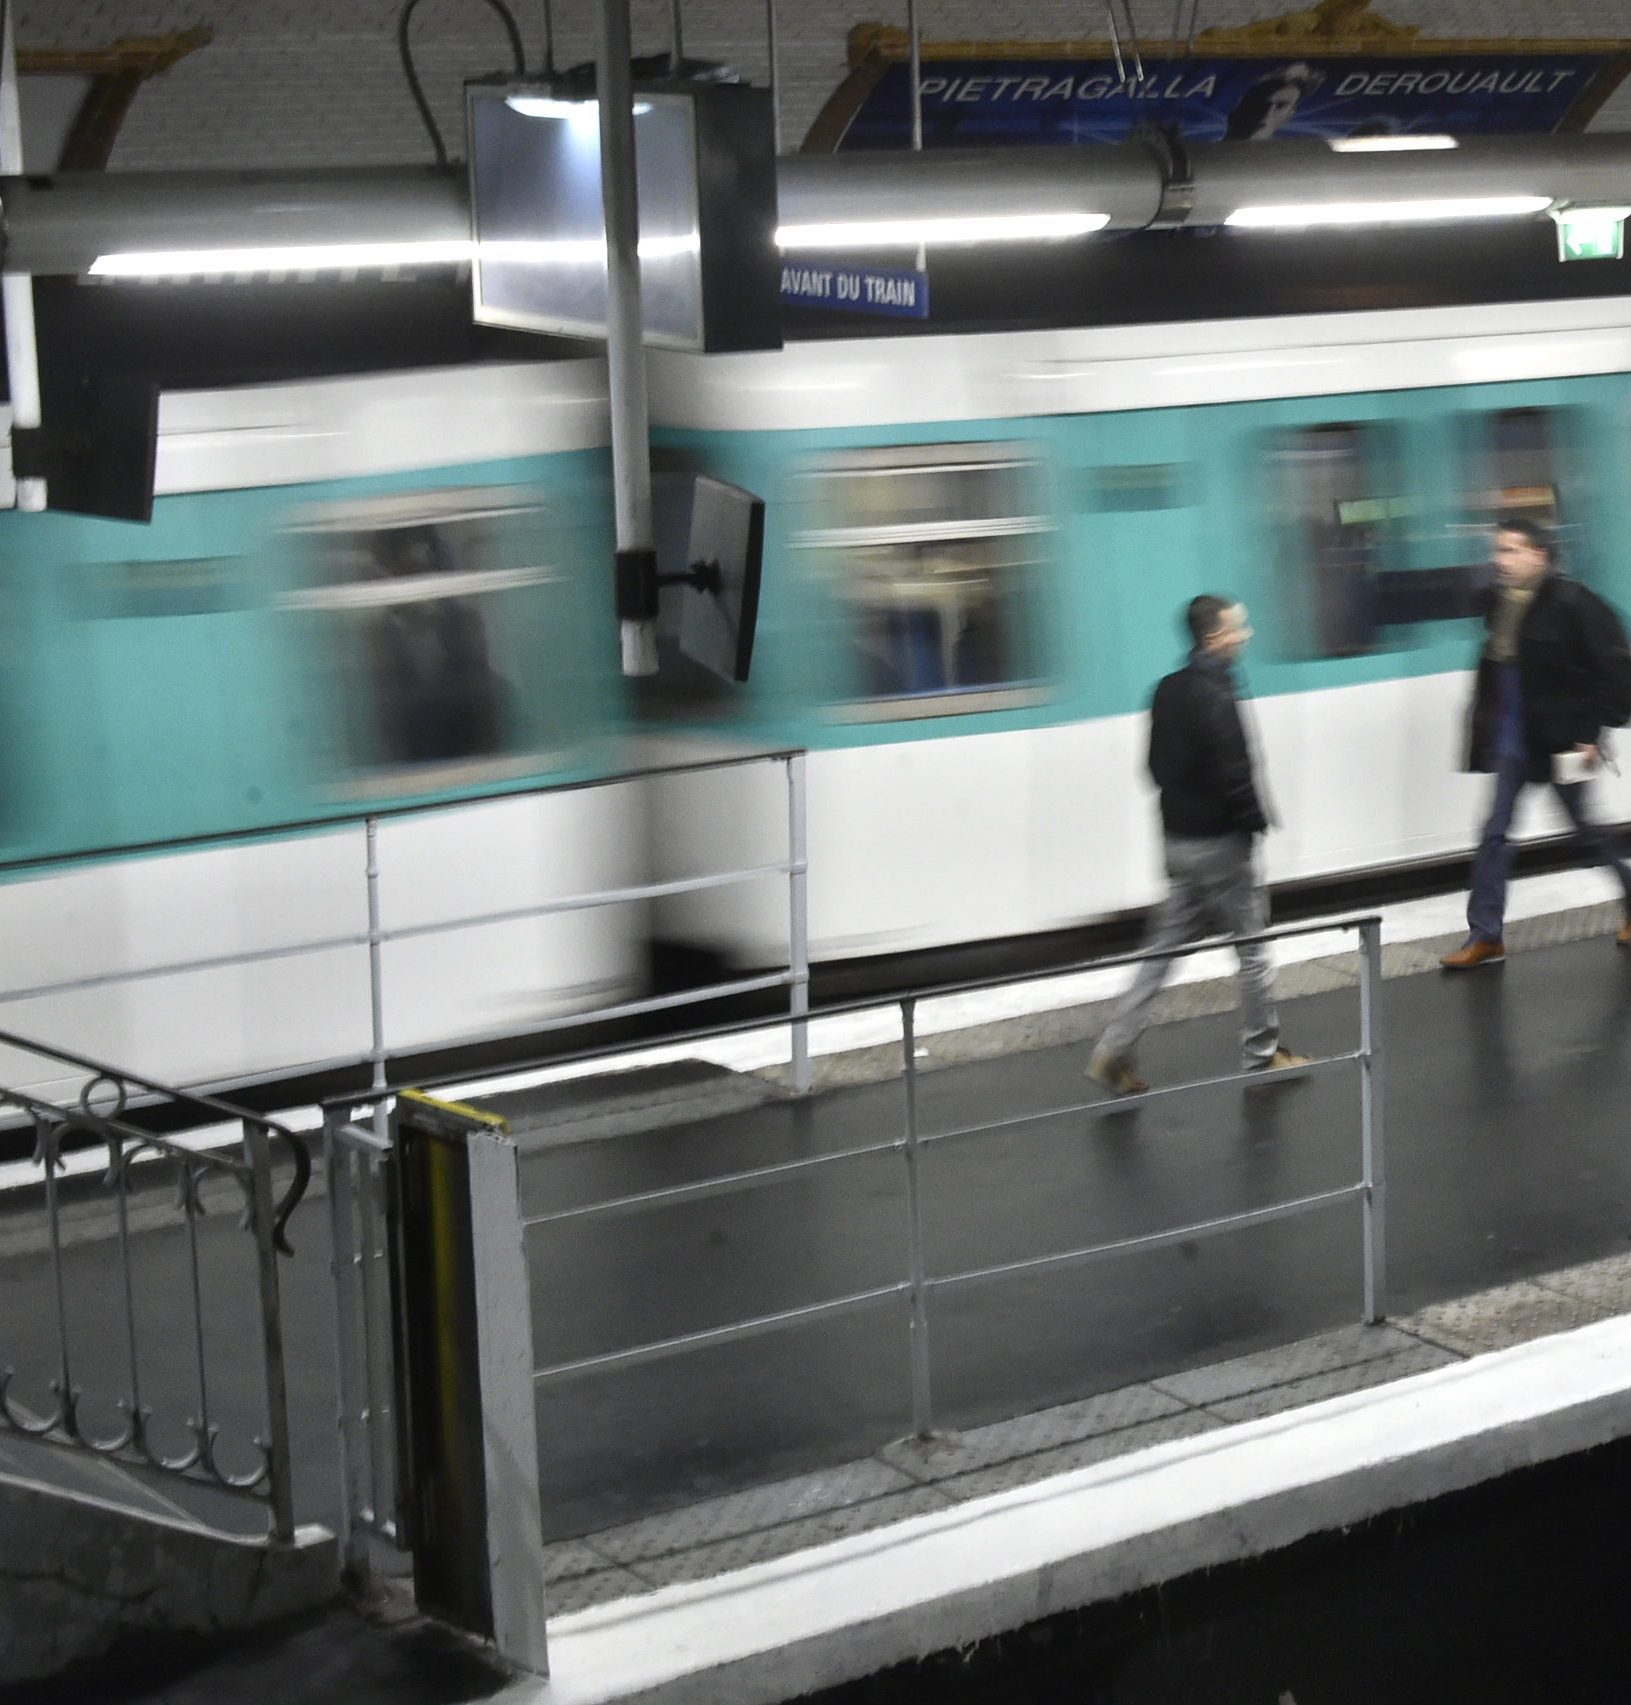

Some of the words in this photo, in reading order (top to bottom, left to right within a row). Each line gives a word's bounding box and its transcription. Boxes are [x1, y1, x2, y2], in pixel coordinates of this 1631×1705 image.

[917, 74, 1217, 102] PIETRAGALLA
[1334, 71, 1576, 97] DEROUAULT
[780, 266, 833, 298] AVANT
[837, 273, 861, 301] DU
[864, 275, 916, 308] TRAIN
